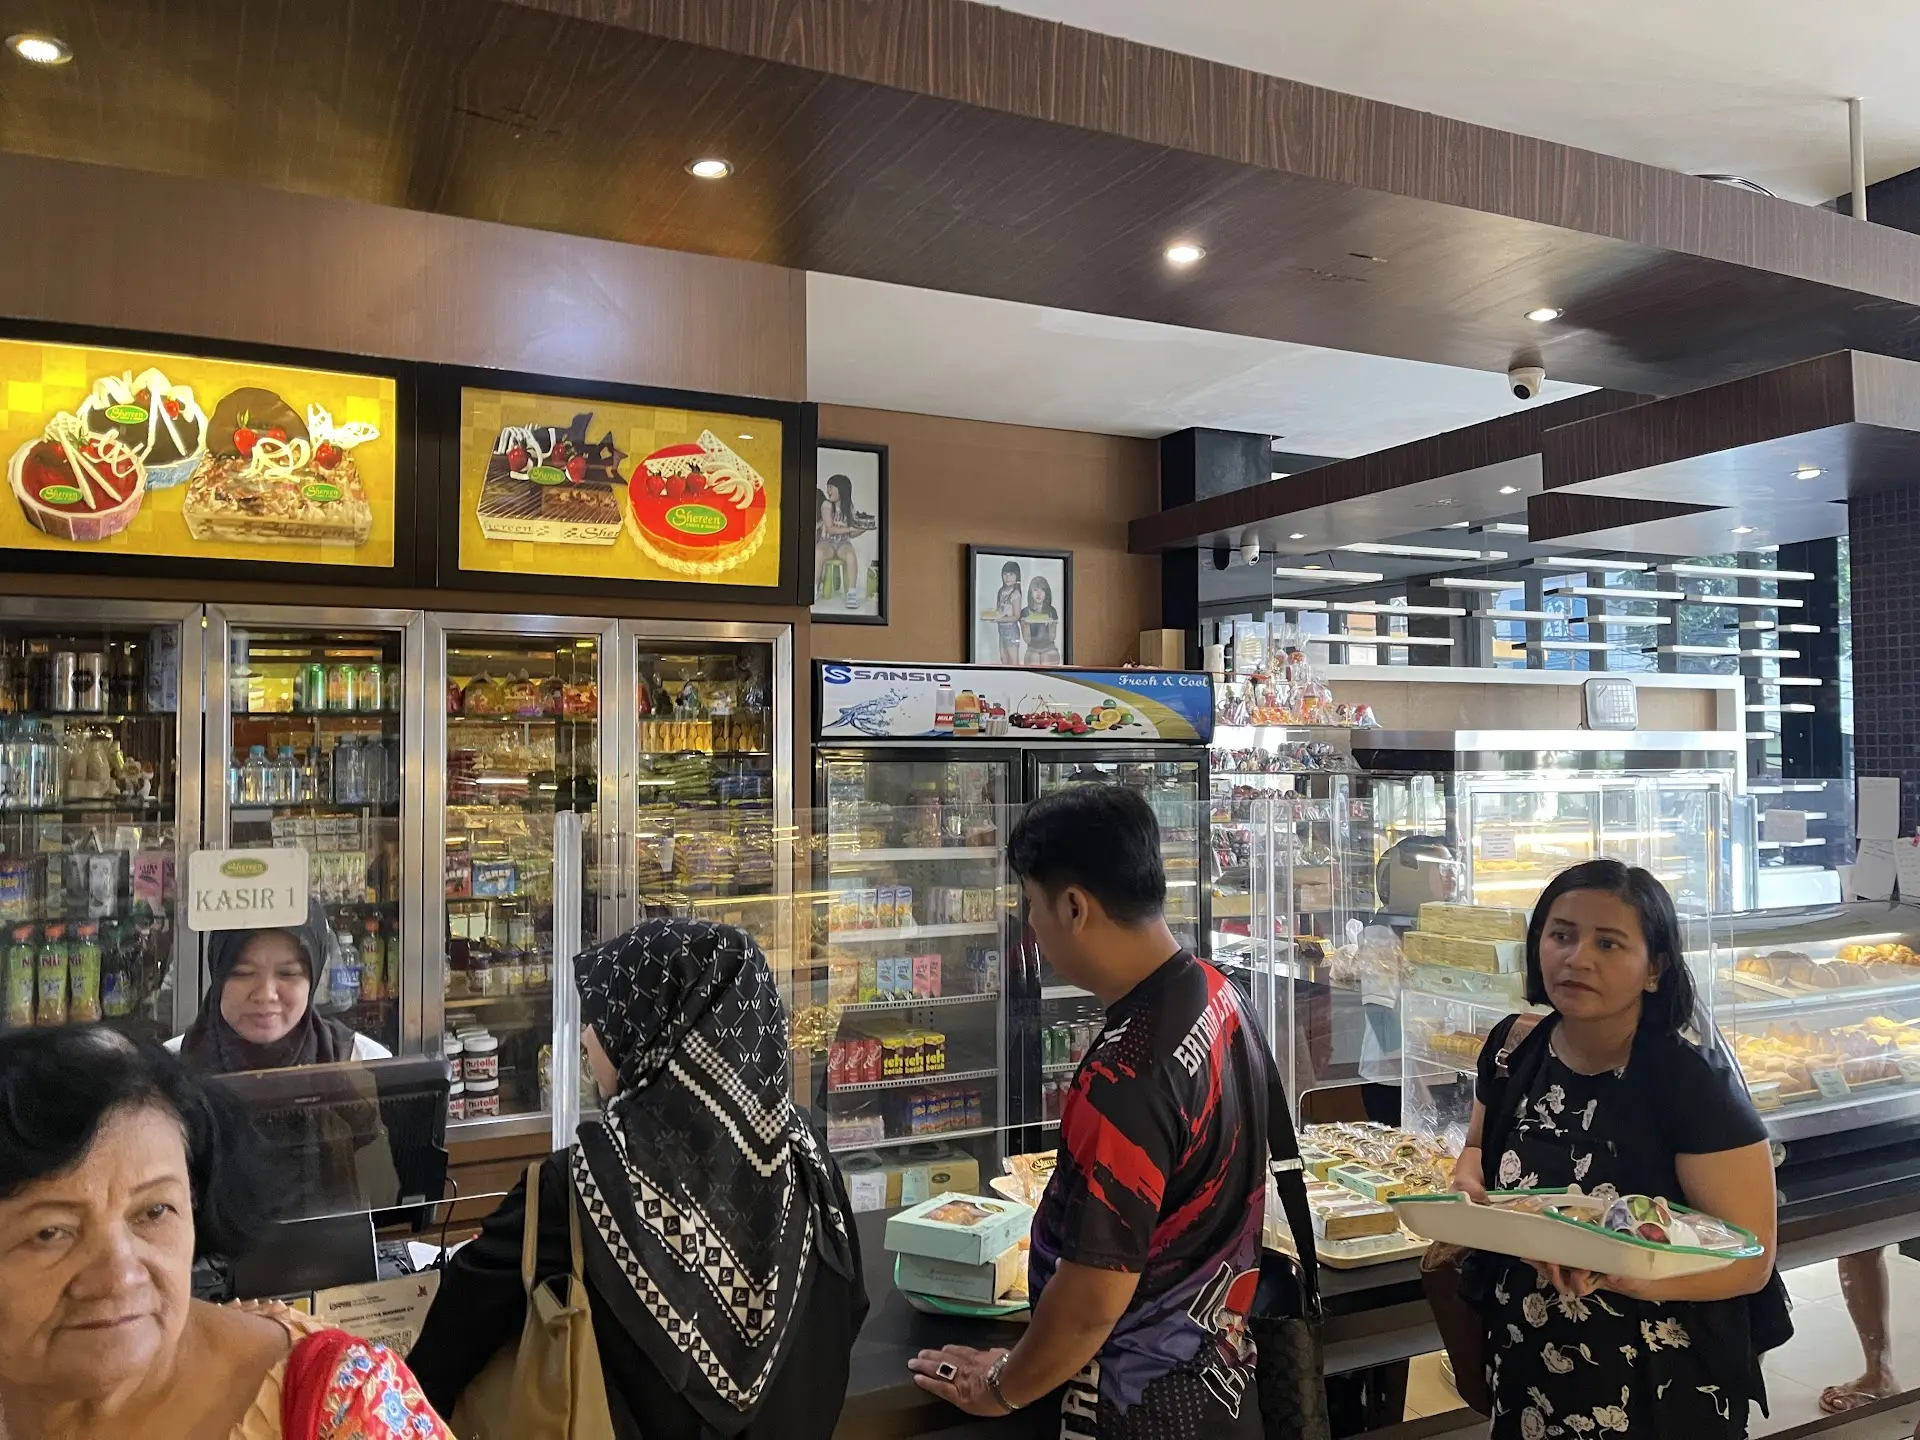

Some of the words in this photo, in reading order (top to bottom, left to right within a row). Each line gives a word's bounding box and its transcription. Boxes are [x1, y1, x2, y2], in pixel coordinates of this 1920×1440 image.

[672, 508, 720, 526] Shereen
[853, 670, 951, 682] SANSIO
[1118, 675, 1158, 686] Fresh
[1162, 676, 1174, 686] &
[1178, 676, 1210, 687] Cool
[196, 888, 275, 911] KASIR
[285, 887, 295, 908] 1
[1173, 1004, 1221, 1077] SATRIA
[466, 1057, 496, 1068] nutella
[883, 1053, 904, 1068] teh
[904, 1051, 924, 1067] teh
[925, 1049, 945, 1063] teh
[469, 1097, 498, 1109] nutella
